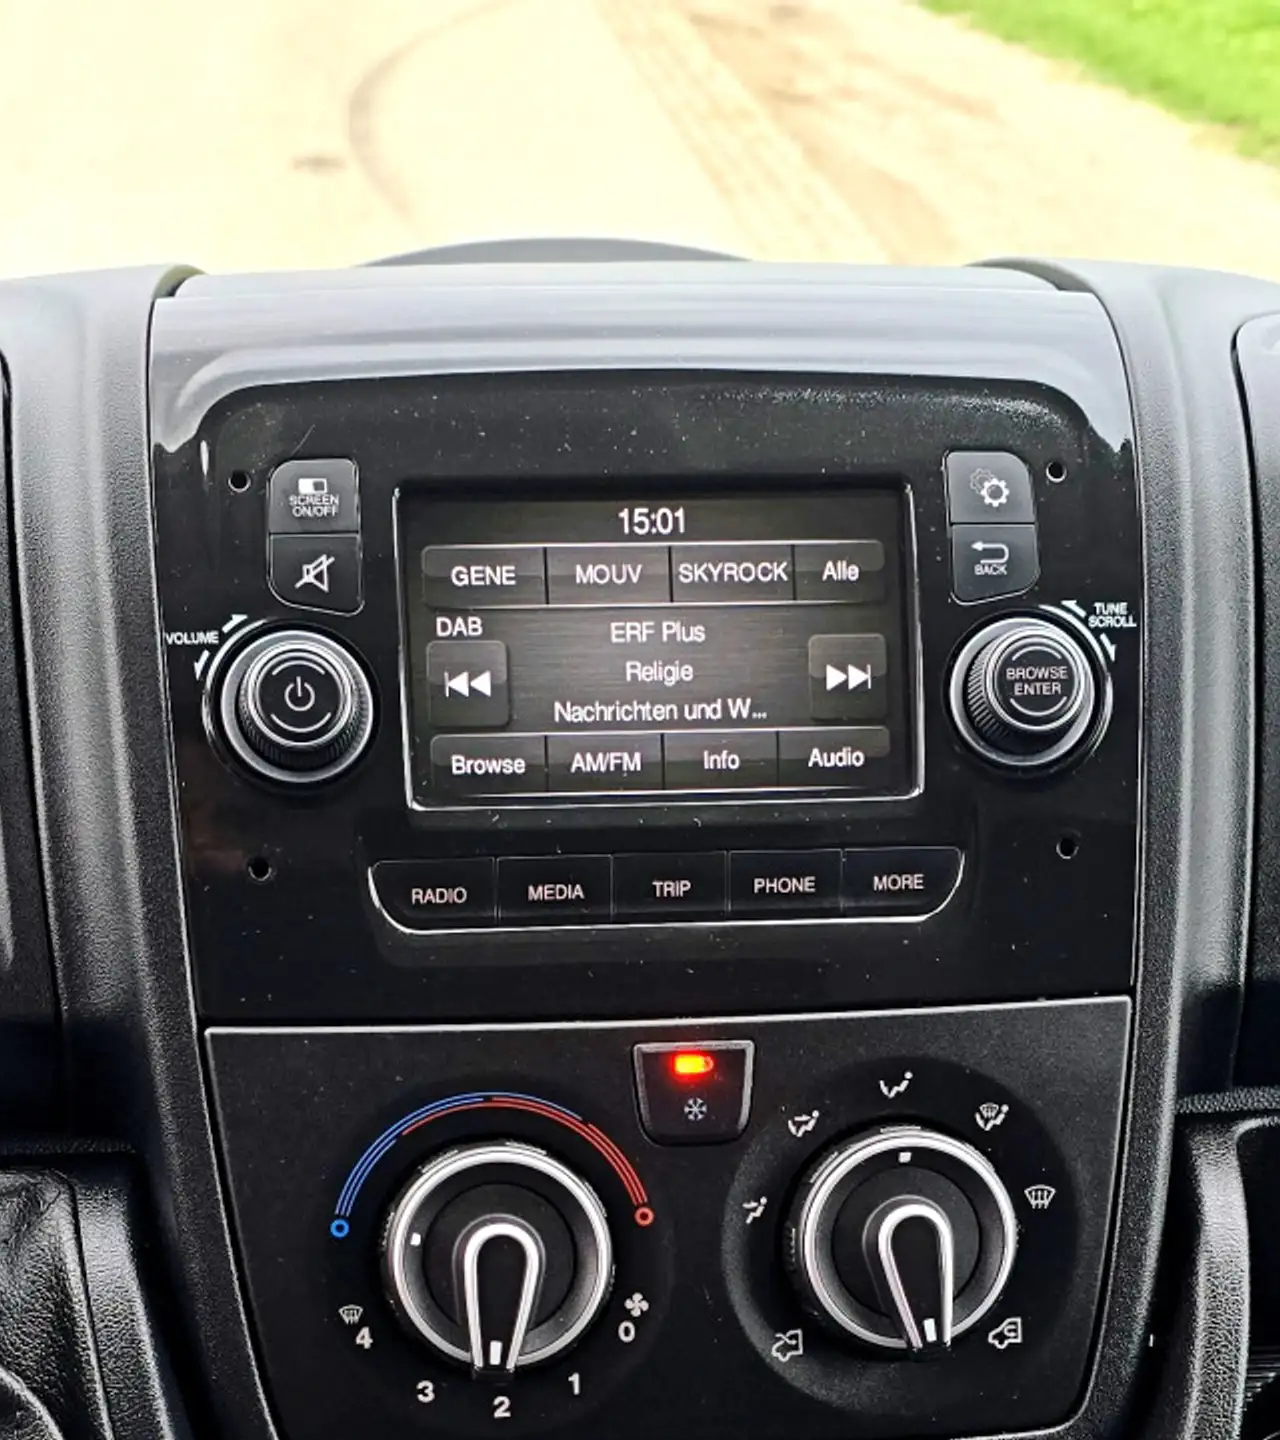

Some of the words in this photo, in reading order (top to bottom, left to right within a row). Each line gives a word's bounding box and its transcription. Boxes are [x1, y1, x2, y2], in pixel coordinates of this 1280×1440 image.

[288, 494, 340, 506] SCREEN
[292, 505, 339, 517] ON/OFF
[618, 507, 687, 535] 15:01
[450, 565, 516, 586] GENE
[575, 564, 643, 585] MOUV
[678, 561, 788, 584] SKYROCK
[822, 562, 860, 581] Alle
[974, 563, 1007, 576] BACK
[1093, 602, 1128, 615] TUNE
[435, 617, 482, 637] DAB
[1088, 614, 1137, 628] SCROLL
[165, 630, 219, 645] VOLUME
[610, 621, 655, 643] ERF
[662, 621, 705, 644] Plus
[625, 660, 694, 688] Religie
[1006, 665, 1068, 681] BROWSE
[1014, 681, 1062, 696] ENTER
[554, 700, 678, 723] Nachrichten
[684, 700, 721, 720] und
[451, 755, 526, 775] Browse
[571, 751, 642, 773] AM/FM
[704, 750, 740, 770] Info
[808, 748, 865, 768] Audio
[527, 882, 585, 901] MEDIA
[652, 880, 691, 899] TRIP
[753, 876, 816, 895] PHONE
[873, 873, 925, 892] MORE
[411, 886, 467, 904] RADIO
[355, 1326, 373, 1349] 4
[618, 1320, 635, 1343] 0
[416, 1380, 435, 1402] 3
[568, 1372, 581, 1395] 1
[493, 1395, 511, 1418] 2
